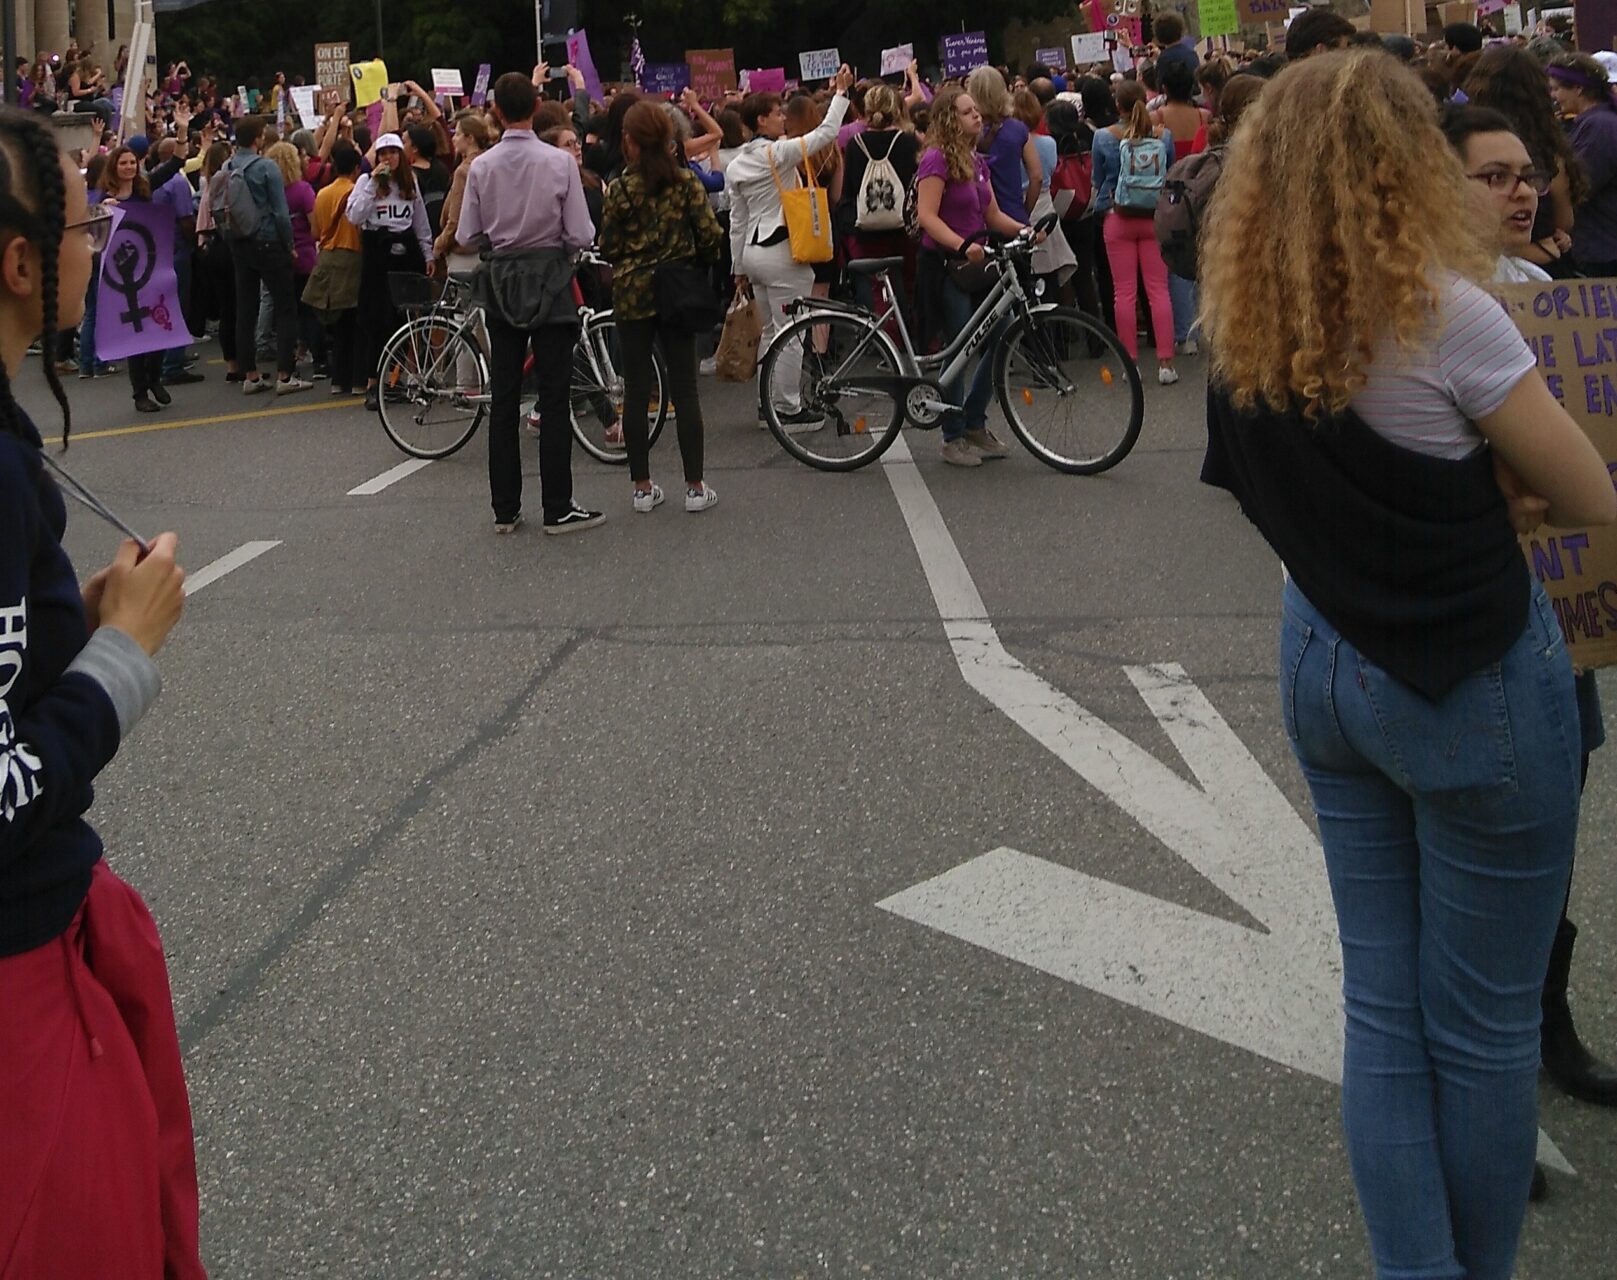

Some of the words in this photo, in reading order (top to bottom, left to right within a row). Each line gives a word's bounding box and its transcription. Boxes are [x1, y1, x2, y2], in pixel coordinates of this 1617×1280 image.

[317, 48, 331, 59] ON
[333, 46, 348, 58] EST
[317, 61, 333, 73] PAS
[376, 205, 411, 219] FILA
[963, 309, 999, 358] PULSE
